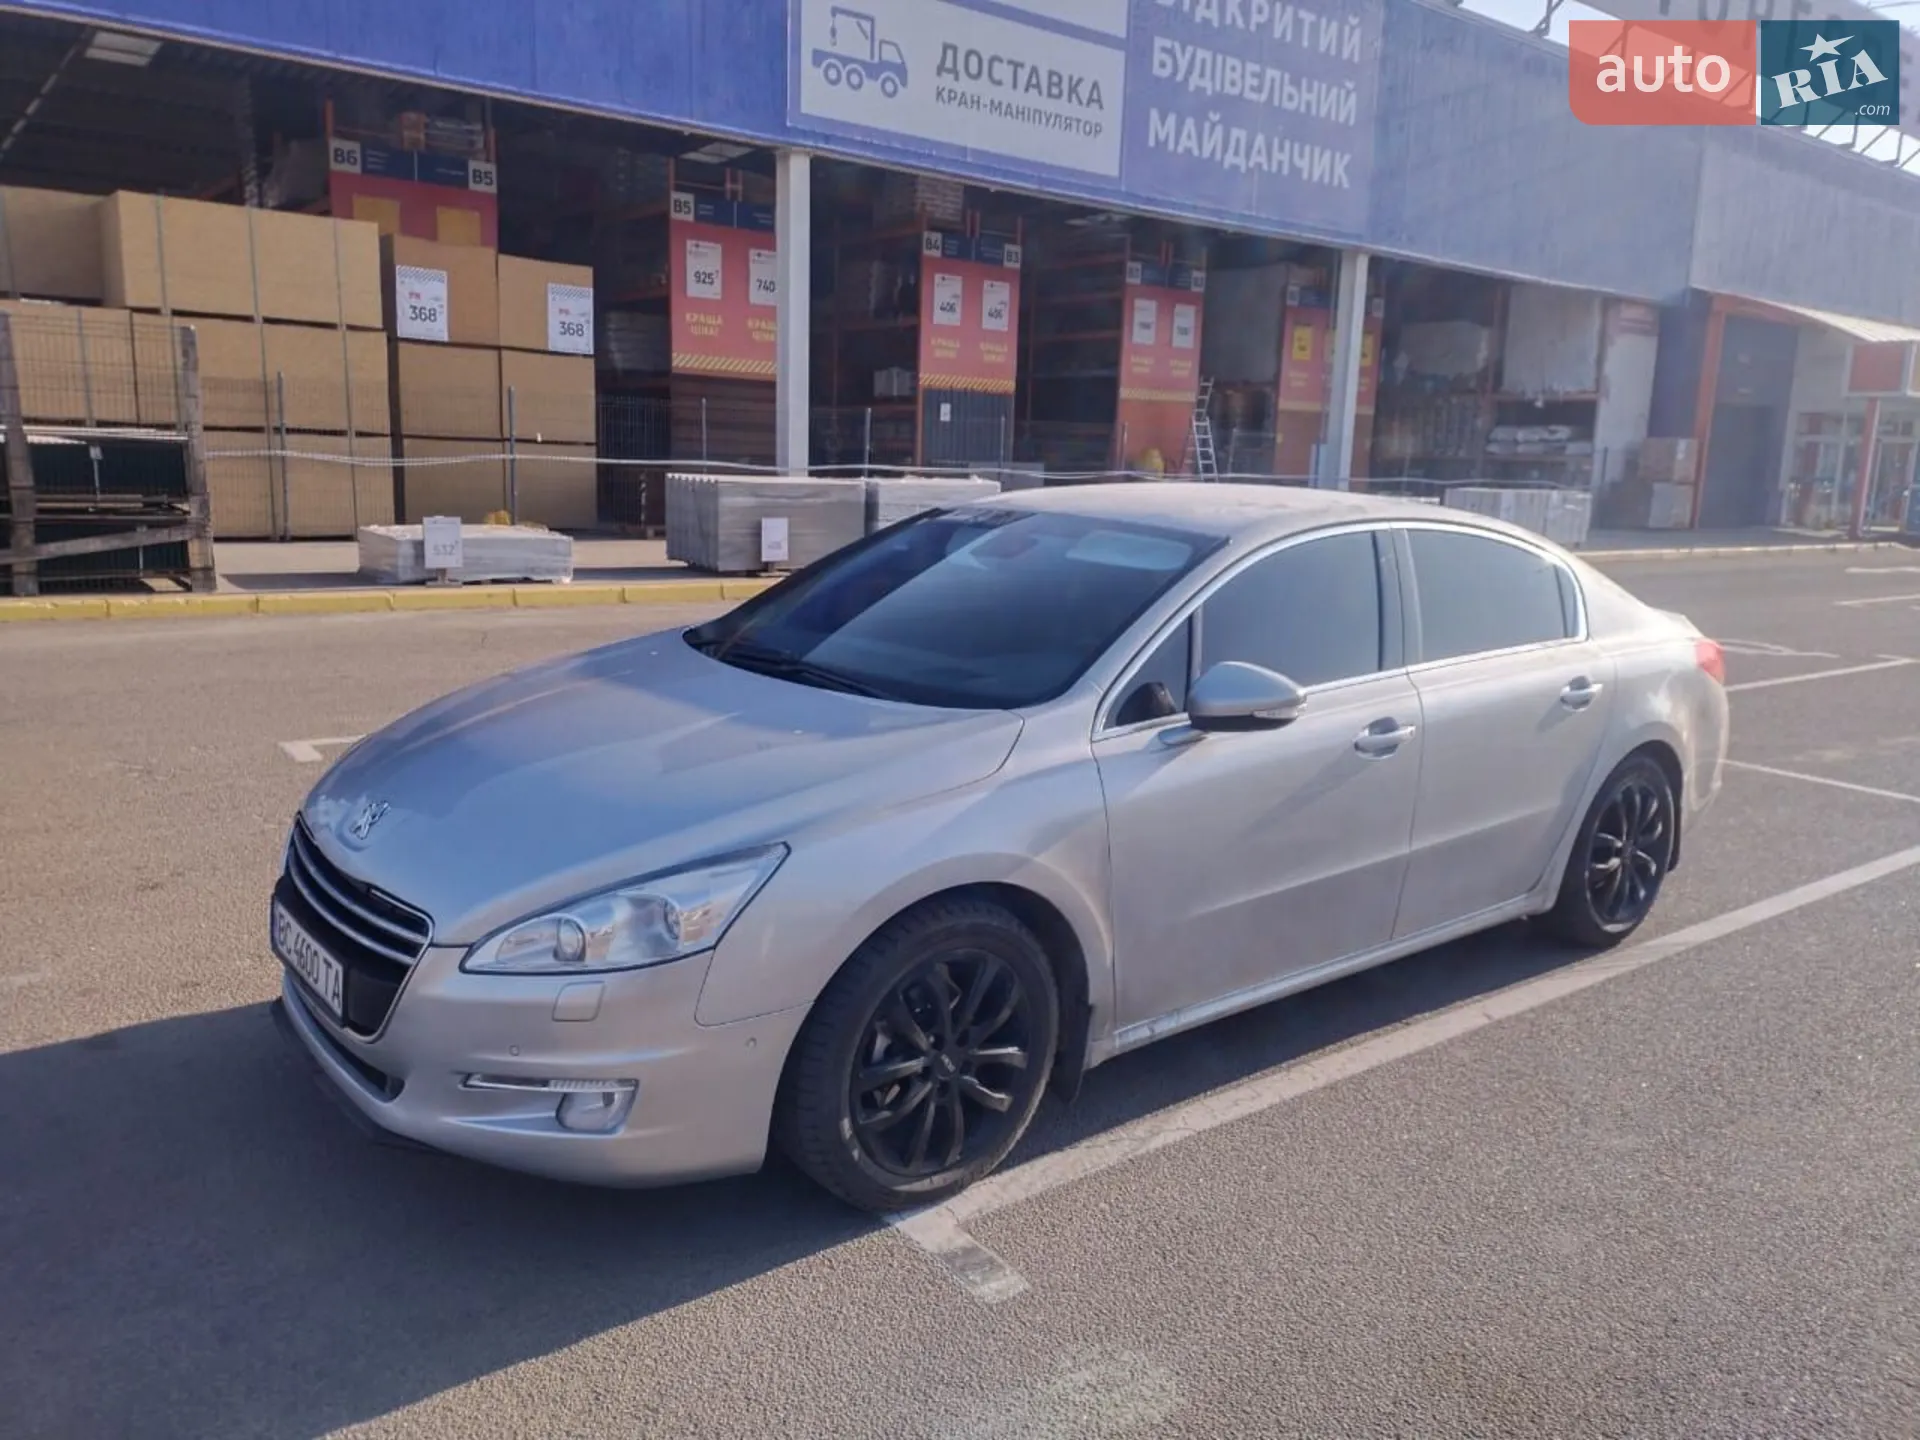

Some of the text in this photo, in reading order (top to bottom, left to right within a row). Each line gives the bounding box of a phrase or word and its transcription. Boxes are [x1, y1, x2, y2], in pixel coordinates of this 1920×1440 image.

[1153, 0, 1362, 63] ДКРИТИЙ
[936, 42, 1105, 111] ДОСТАВКА
[1152, 36, 1357, 126] БУДІВЕЛЬНИЙ
[935, 85, 1104, 139] КРАН-МАНІПУЛЯТОР
[1148, 108, 1352, 189] МАЙДАНЧИК
[409, 304, 438, 323] 368
[558, 320, 585, 338] 368
